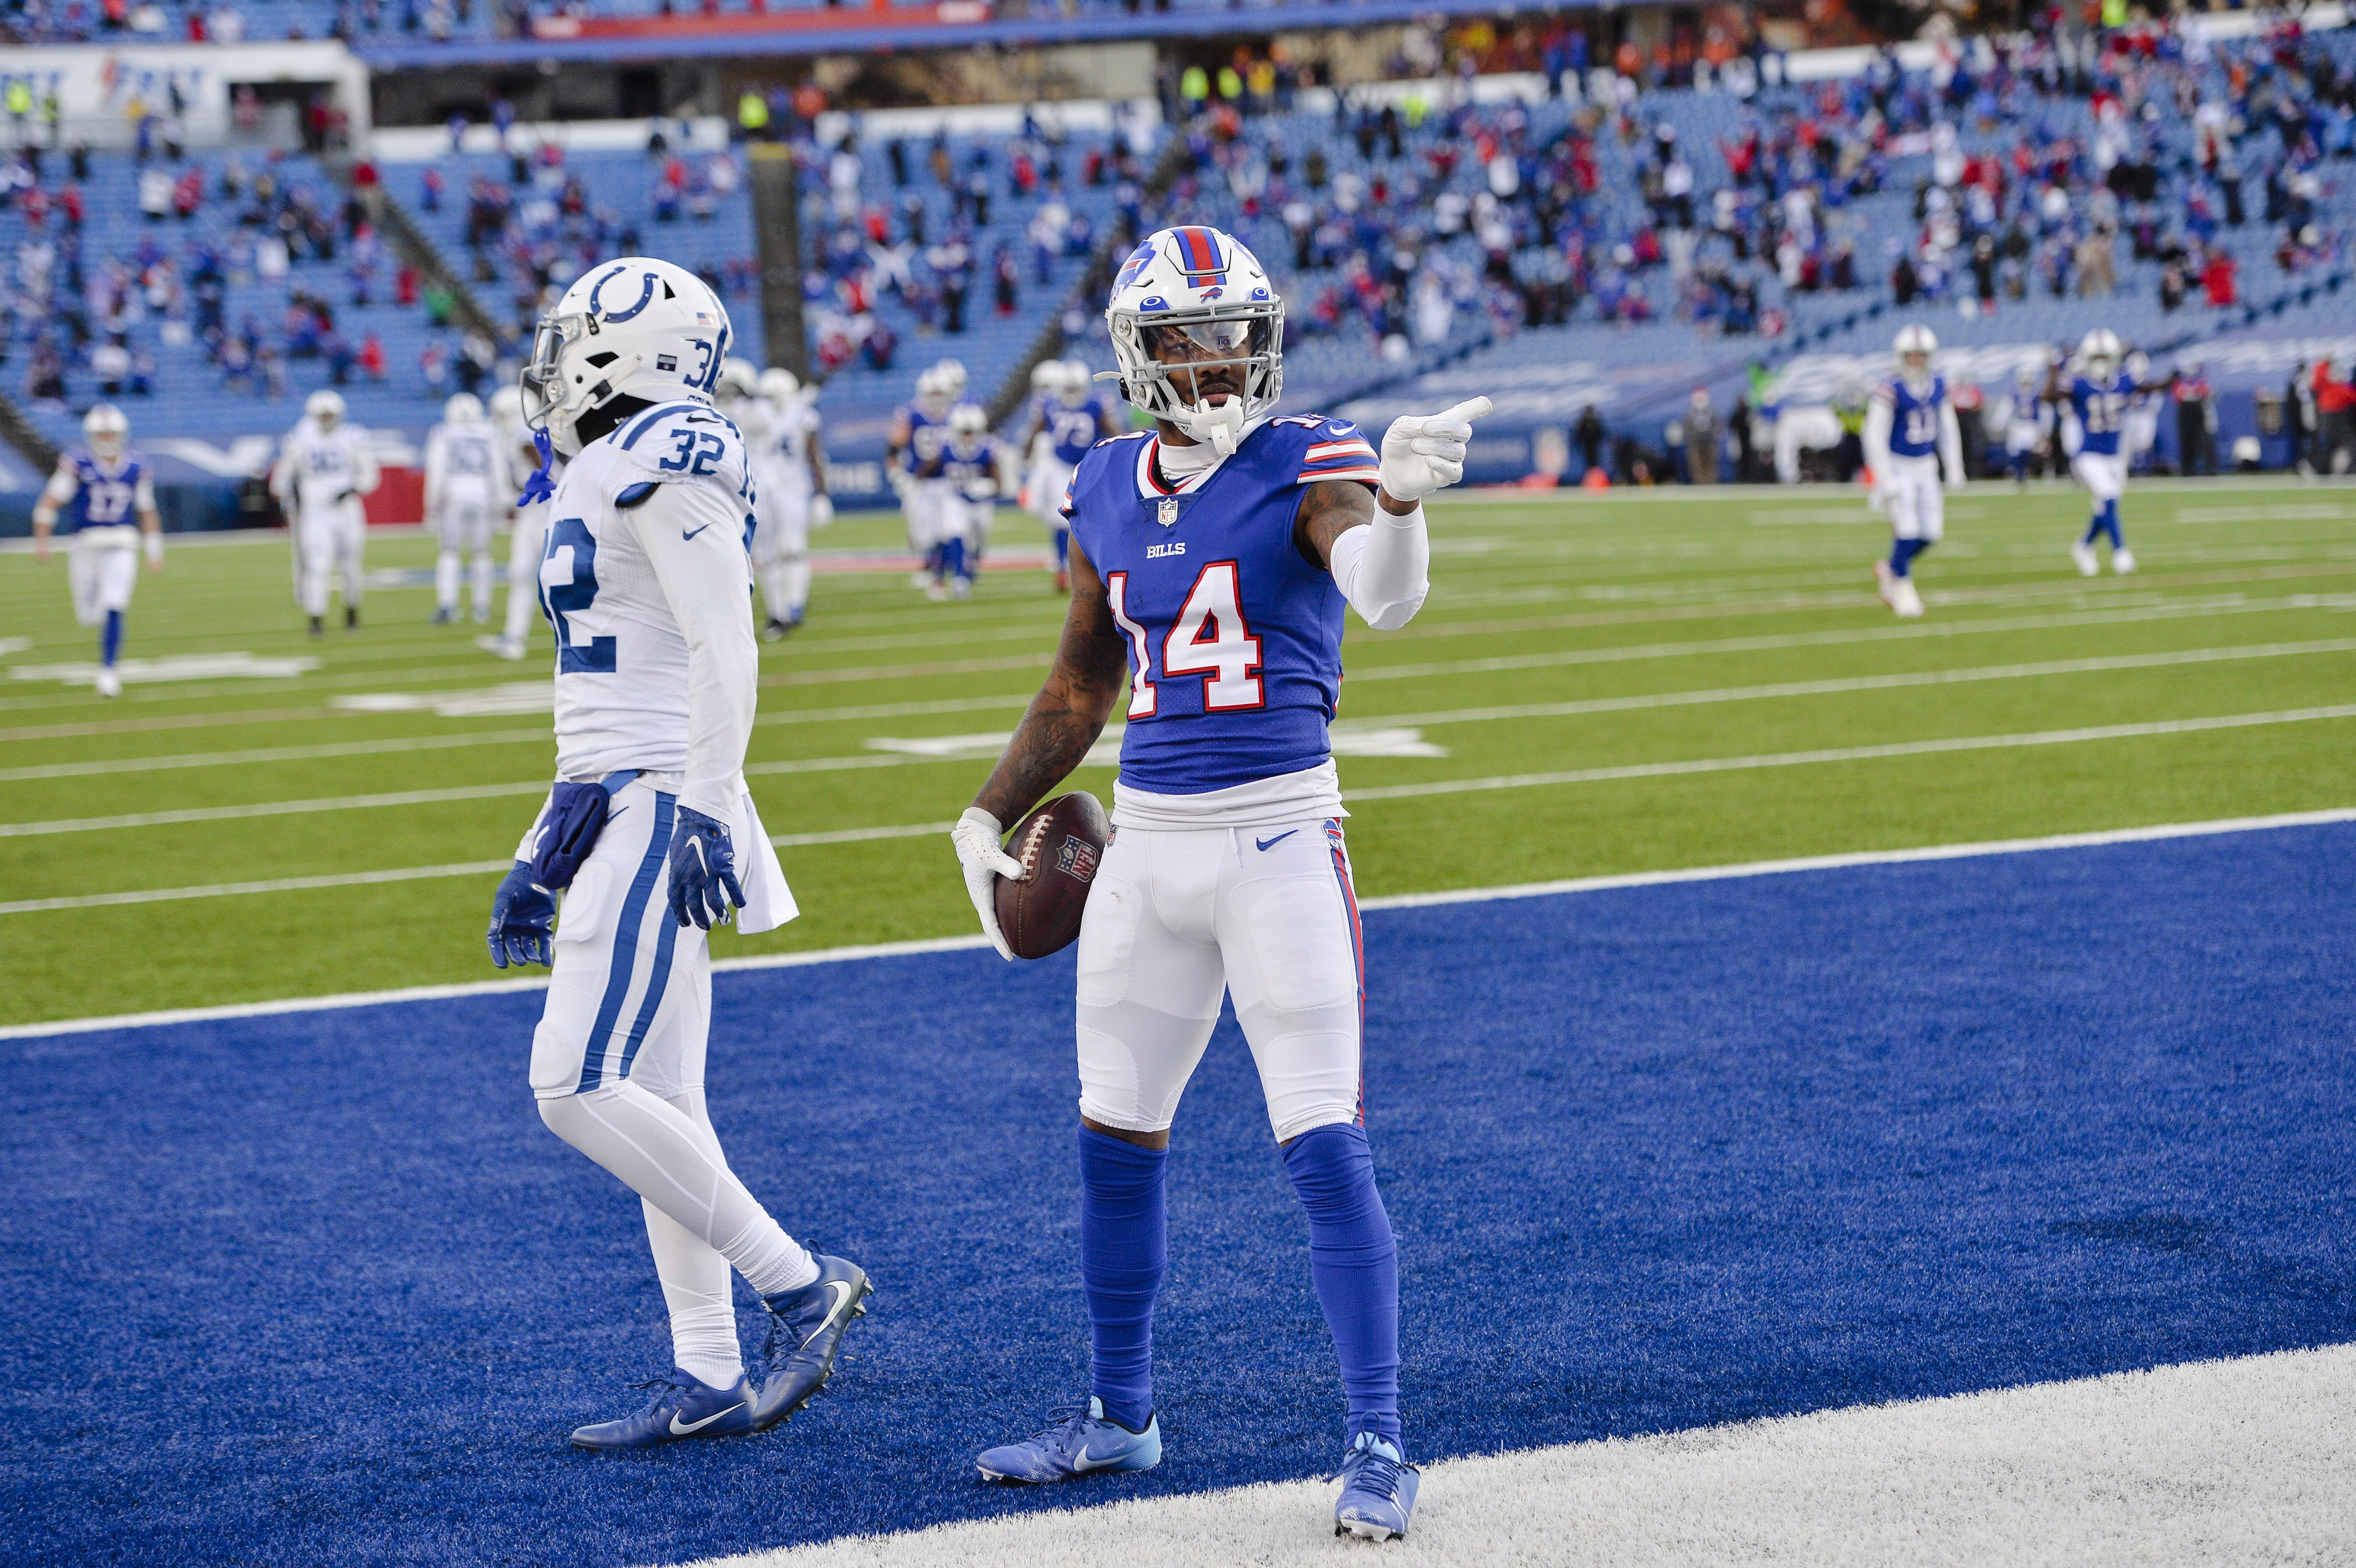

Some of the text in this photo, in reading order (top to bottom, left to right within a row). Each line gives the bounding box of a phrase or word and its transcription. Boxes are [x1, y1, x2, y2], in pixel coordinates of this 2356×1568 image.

[1050, 411, 1095, 448] 73
[659, 429, 726, 477] 32
[1161, 510, 1175, 522] NFL
[1146, 542, 1186, 559] BILLS
[1107, 559, 1266, 722] 14
[1072, 849, 1096, 878] NFL
